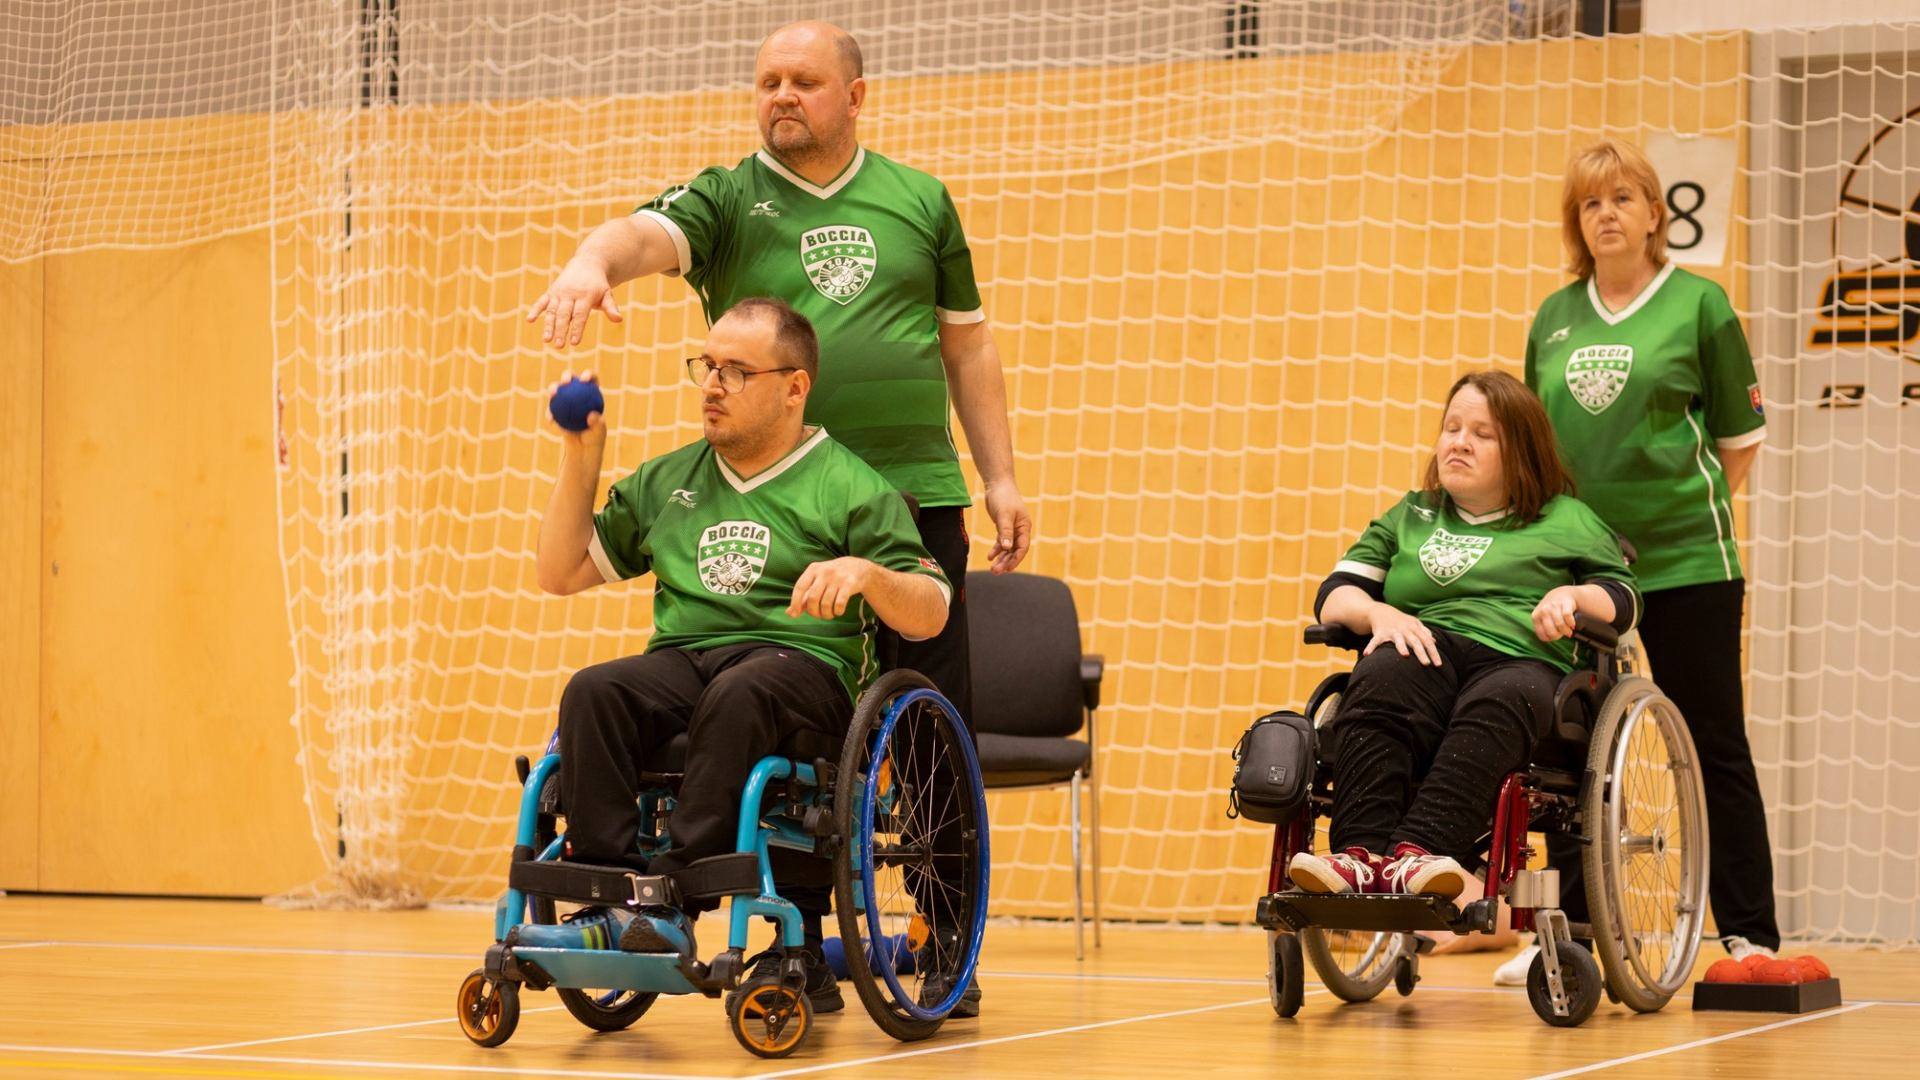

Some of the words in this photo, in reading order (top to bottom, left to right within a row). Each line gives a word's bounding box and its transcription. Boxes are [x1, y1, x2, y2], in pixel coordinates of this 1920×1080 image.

[1666, 182, 1705, 250] 8
[805, 229, 867, 247] BOCCIA
[1578, 349, 1630, 359] BOCCIA
[708, 526, 766, 541] BOCCIA
